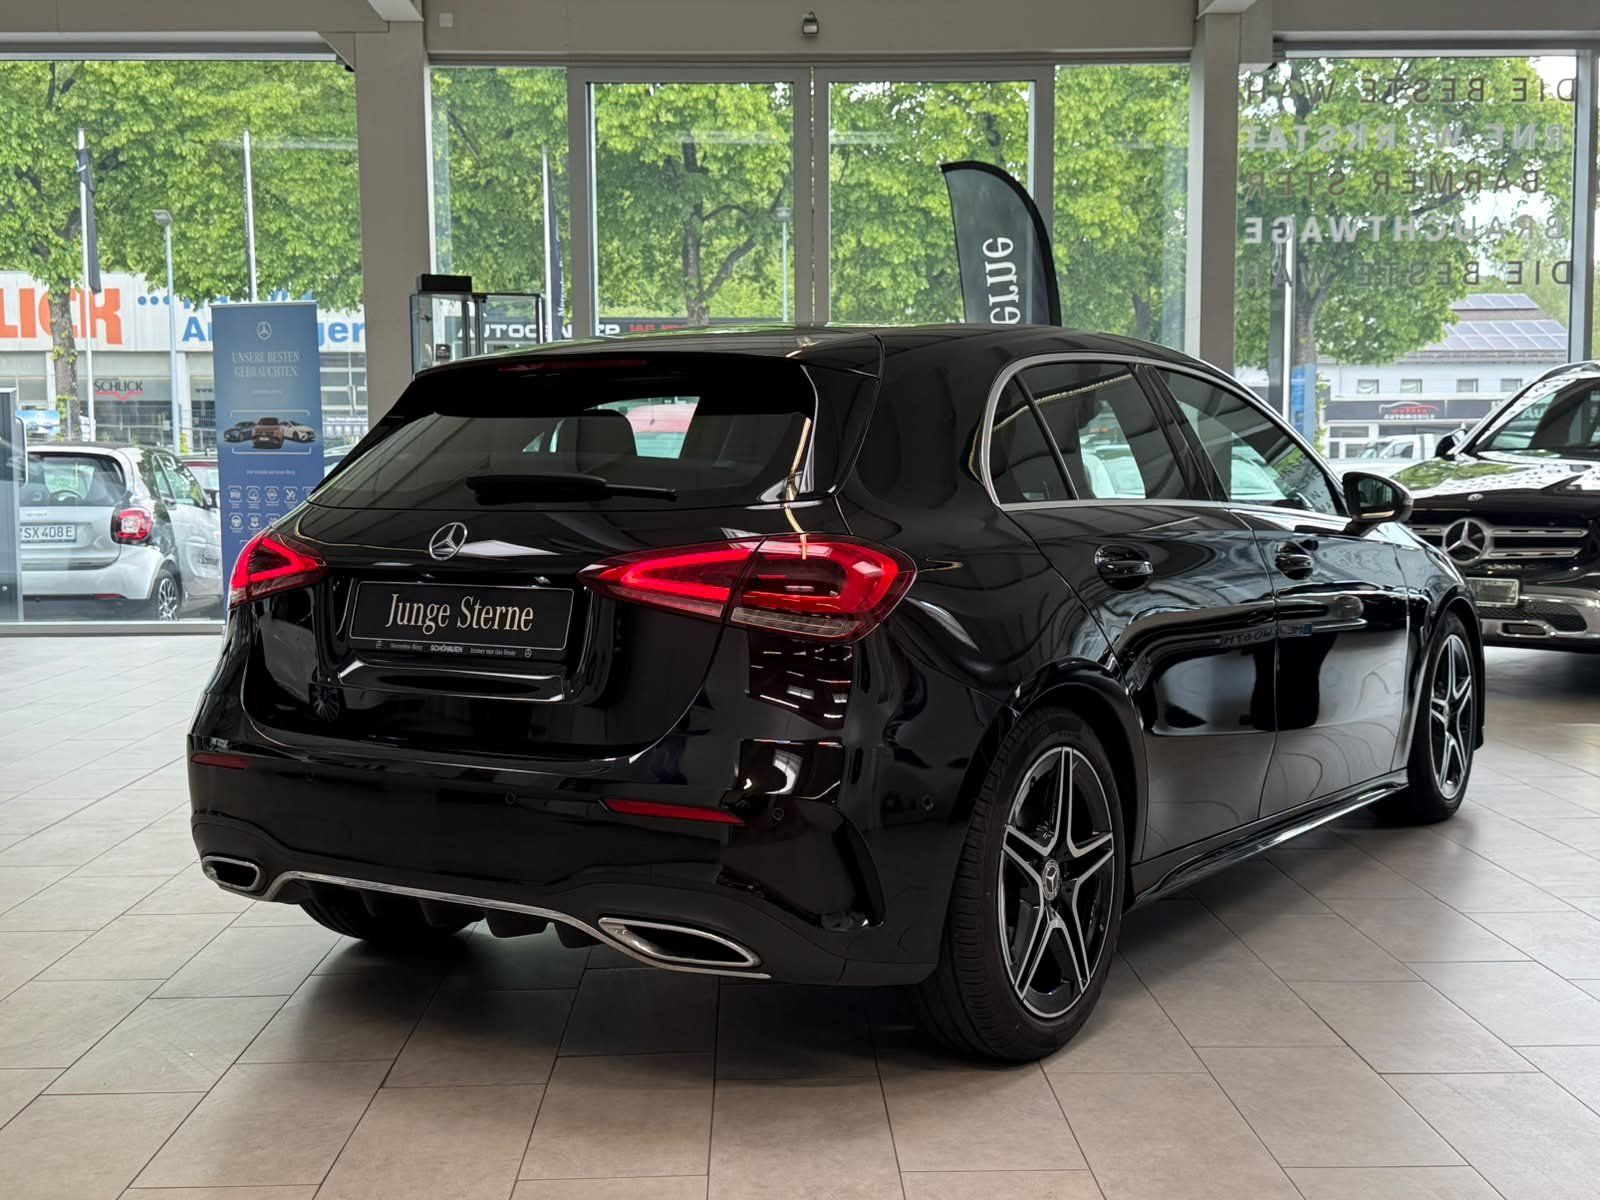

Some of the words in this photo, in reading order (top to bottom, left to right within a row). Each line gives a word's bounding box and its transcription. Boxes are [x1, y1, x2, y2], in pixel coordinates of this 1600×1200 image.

[94, 381, 143, 392] SCHLICK
[385, 593, 450, 635] Junge
[456, 596, 534, 632] Sterne
